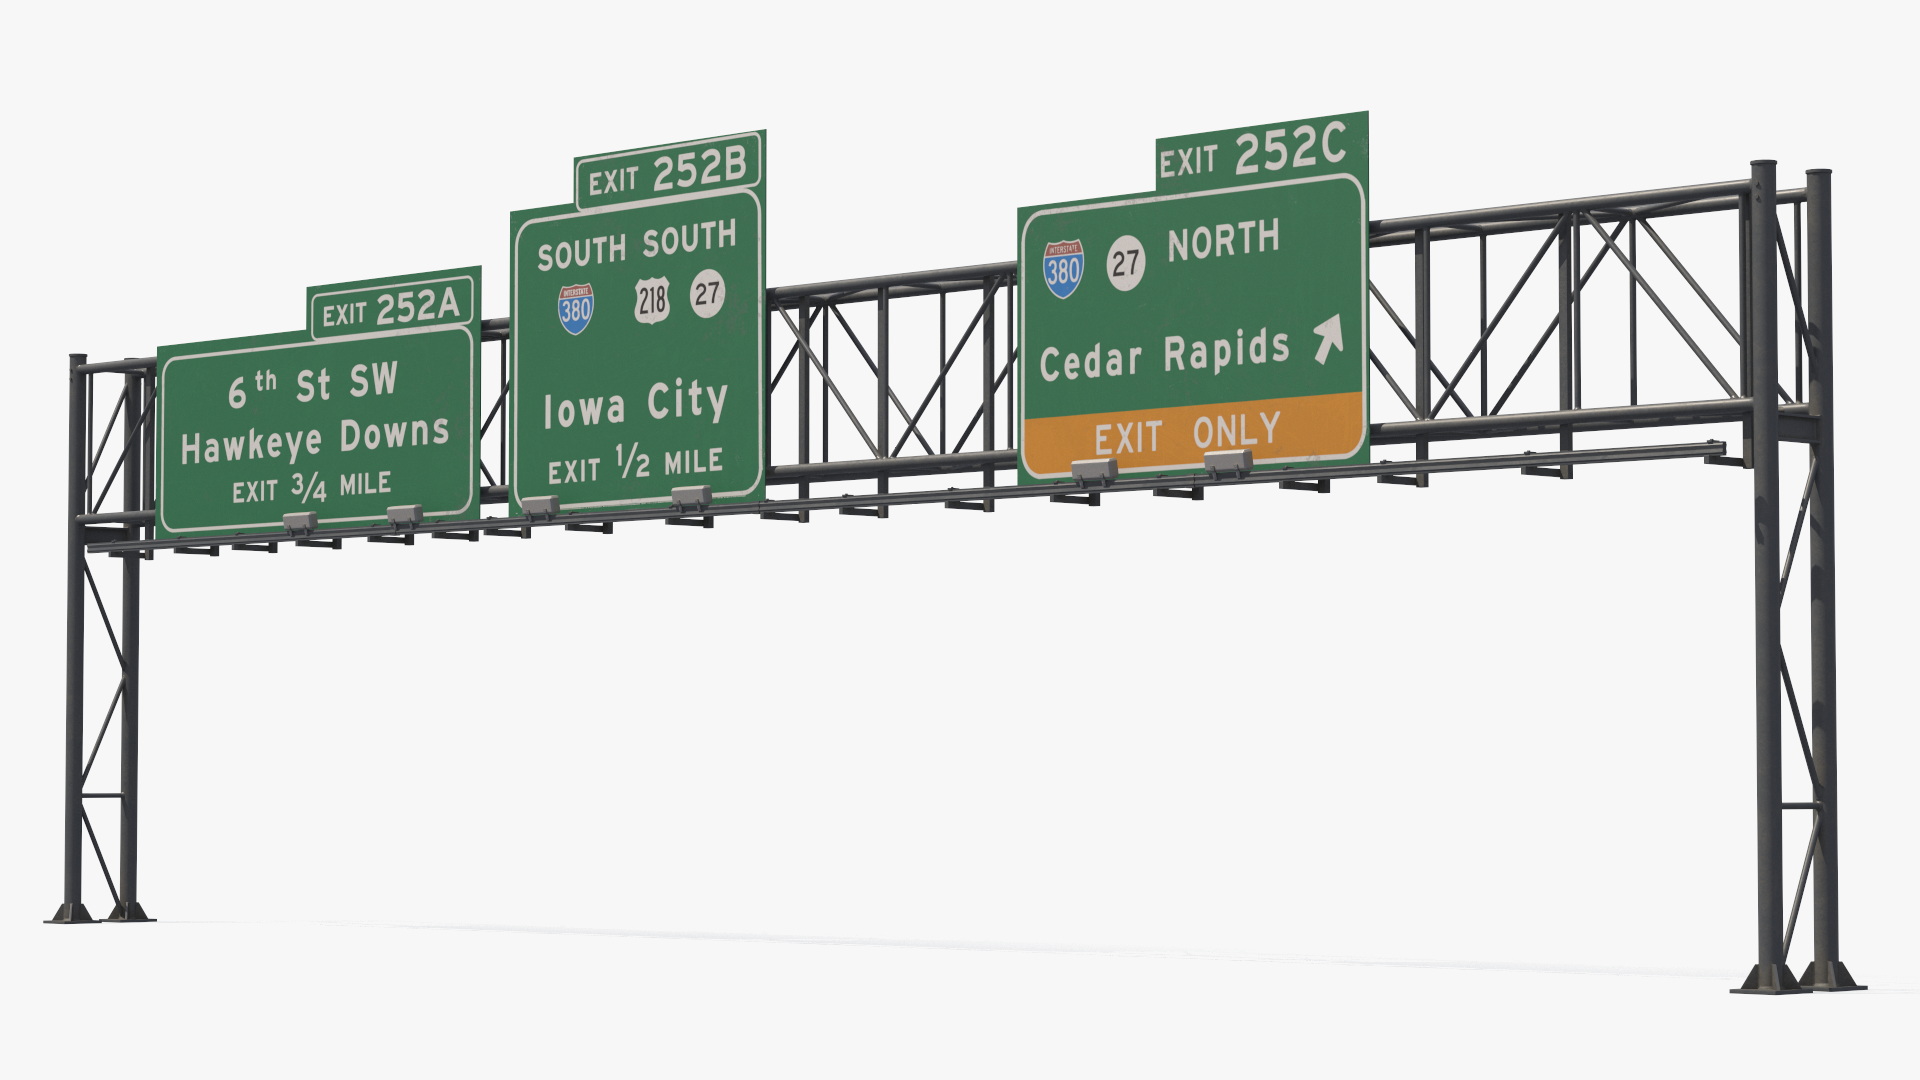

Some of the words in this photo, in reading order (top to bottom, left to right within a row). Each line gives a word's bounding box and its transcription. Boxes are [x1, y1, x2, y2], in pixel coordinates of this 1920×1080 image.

[1160, 144, 1218, 179] EXIT
[1235, 120, 1347, 175] 252C
[589, 166, 639, 196] EXIT
[653, 144, 747, 192] 252B
[537, 233, 626, 272] SOUTH
[642, 218, 736, 258] SOUTH
[1049, 244, 1078, 254] INTERSTATE
[1168, 217, 1279, 262] NORTH
[1047, 257, 1080, 285] 380
[1112, 249, 1140, 277] 27
[323, 302, 367, 327] EXIT
[376, 287, 460, 325] 252A
[561, 298, 591, 323] 380
[563, 287, 589, 297] INTERSTATE
[639, 285, 666, 315] 218
[695, 281, 720, 306] 27
[1040, 342, 1142, 382] Cedar
[1164, 326, 1290, 376] Rapids
[296, 368, 331, 403] St
[349, 360, 398, 397] SW
[544, 394, 625, 429] Iowa
[647, 377, 728, 424] City
[181, 428, 322, 465] Hawkeye
[340, 417, 449, 452] Downs
[1095, 419, 1163, 456] EXIT
[1193, 410, 1281, 449] ONLY
[549, 458, 600, 484] EXIT
[665, 447, 723, 475] MILE
[233, 479, 278, 504] EXIT
[340, 470, 391, 496] MILE
